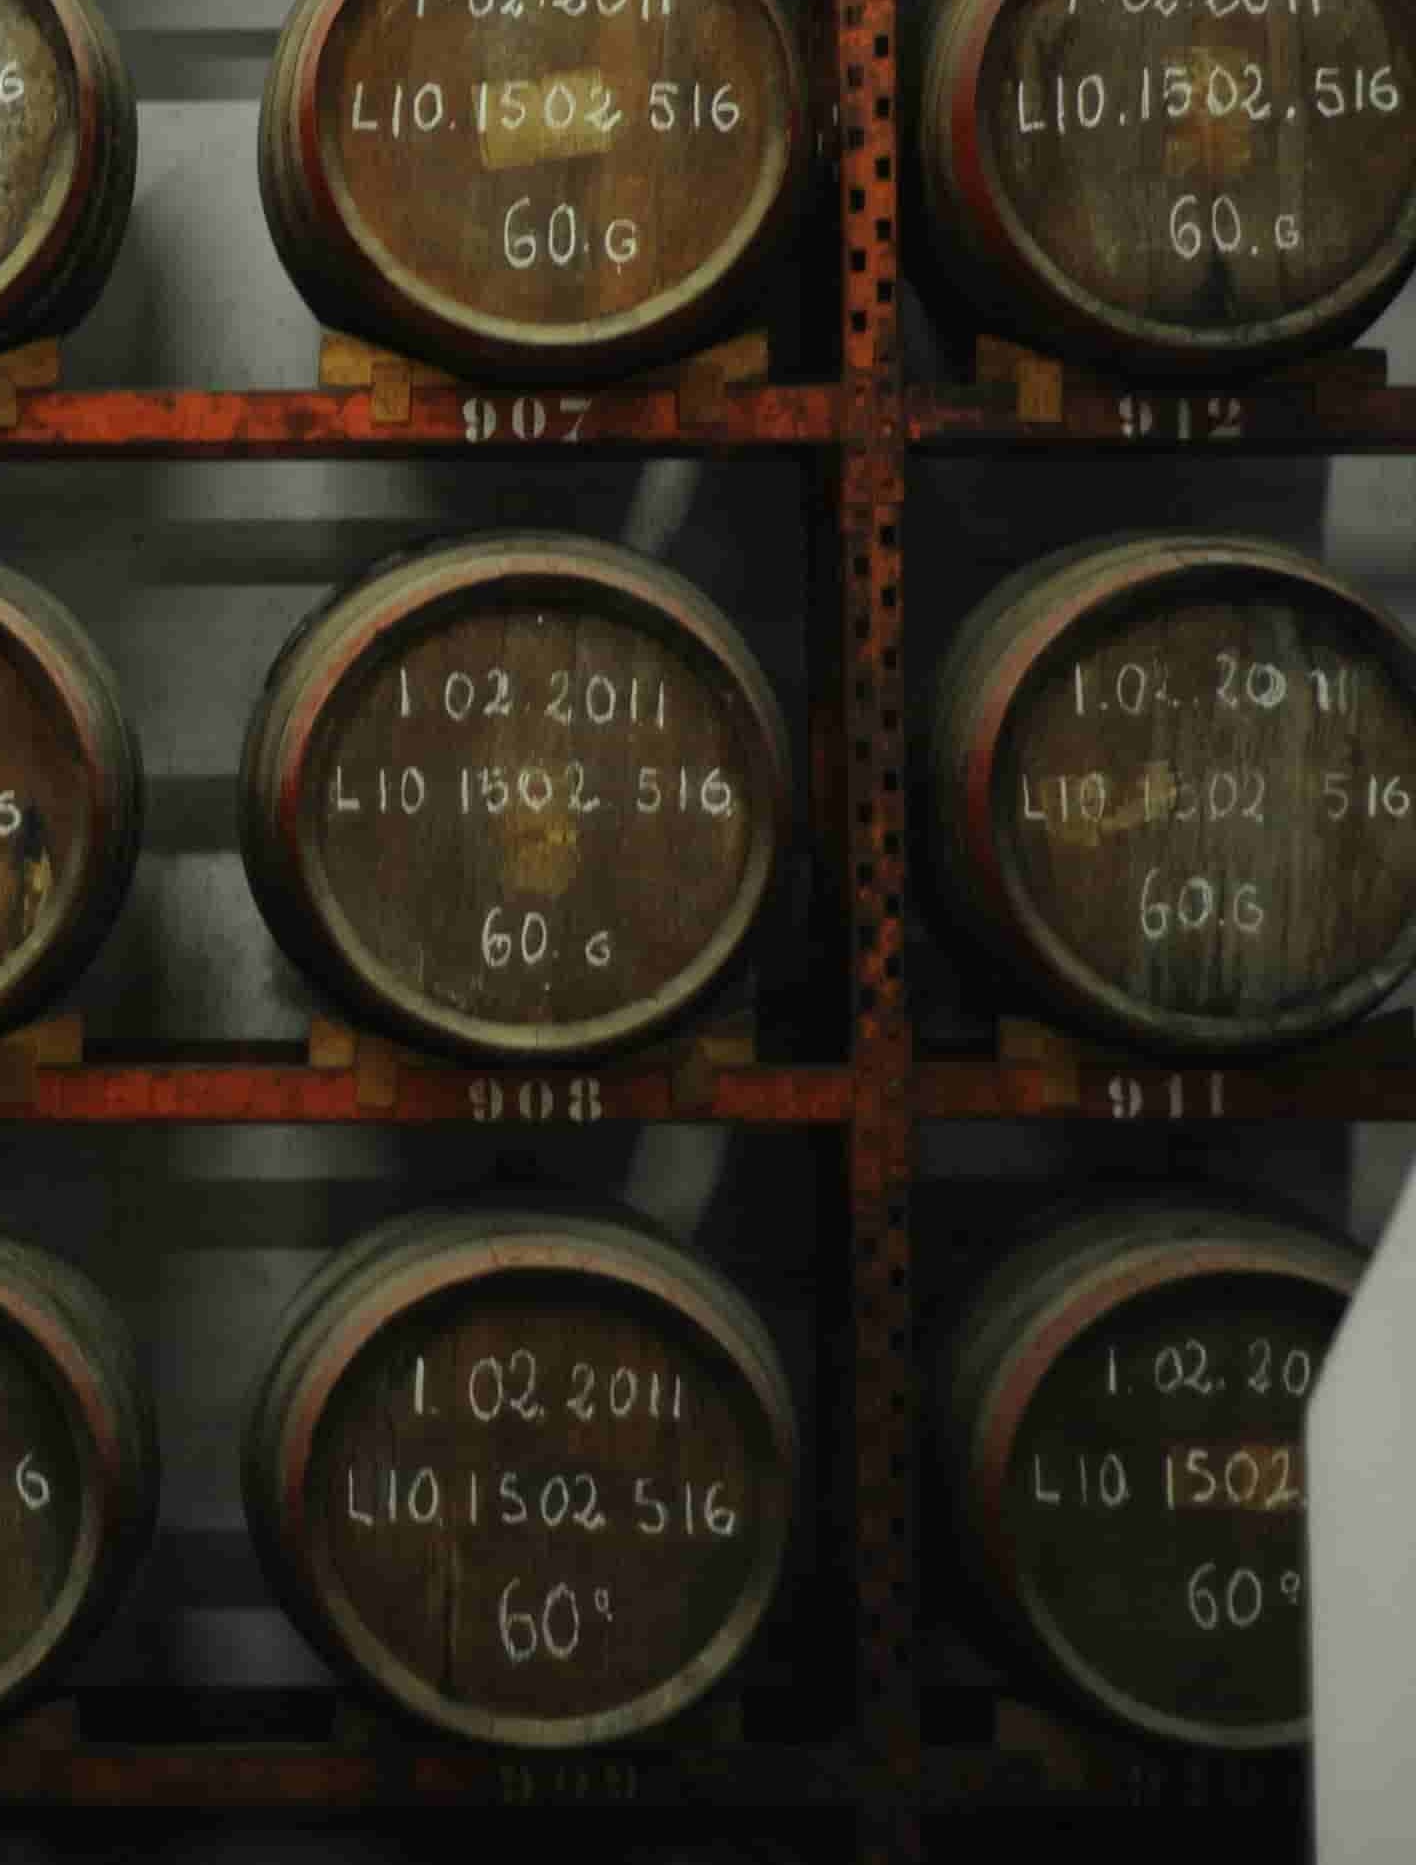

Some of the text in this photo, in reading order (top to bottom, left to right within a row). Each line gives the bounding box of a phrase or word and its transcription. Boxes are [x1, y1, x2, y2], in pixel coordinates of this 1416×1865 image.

[461, 396, 592, 444] 907
[467, 1075, 603, 1123] 908
[1107, 1071, 1225, 1120] 911
